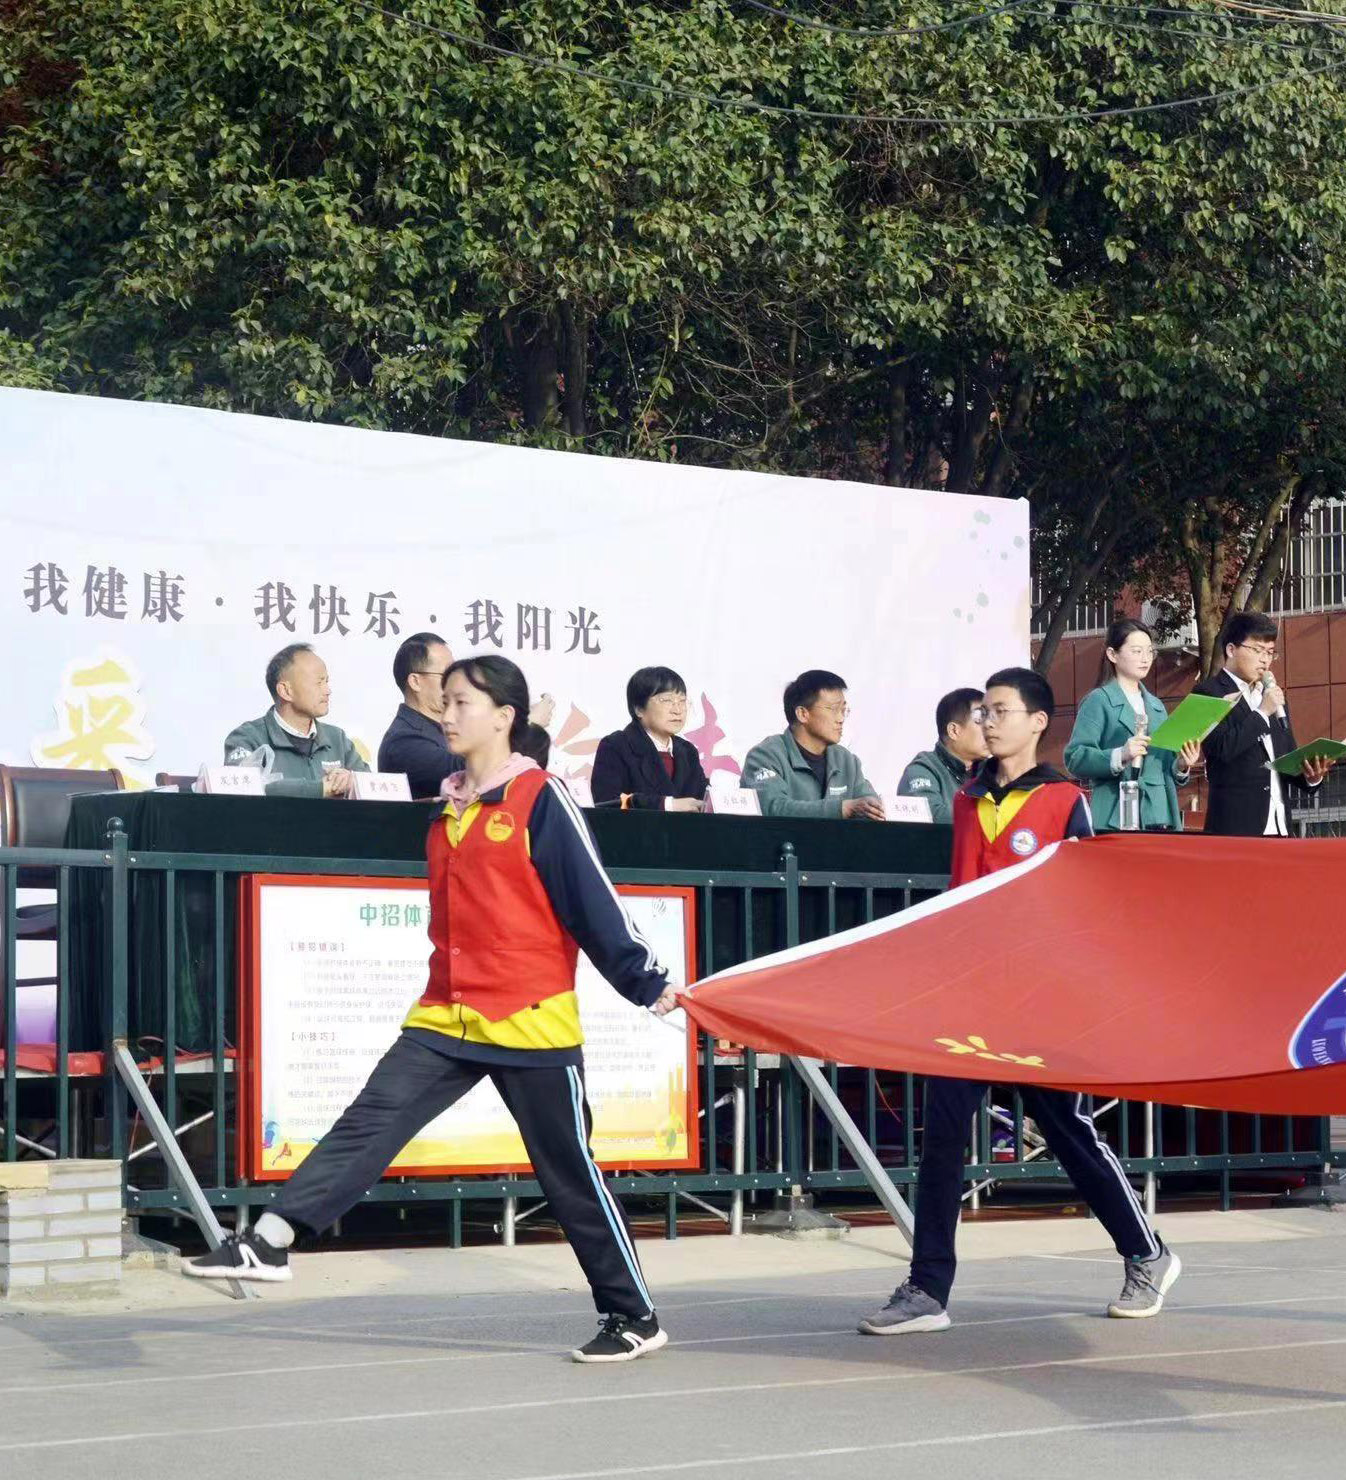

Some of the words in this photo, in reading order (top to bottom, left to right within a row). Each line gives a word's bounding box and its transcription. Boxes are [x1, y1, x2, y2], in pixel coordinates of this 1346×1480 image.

[23, 561, 603, 656] 我健康·我快乐·我阳光
